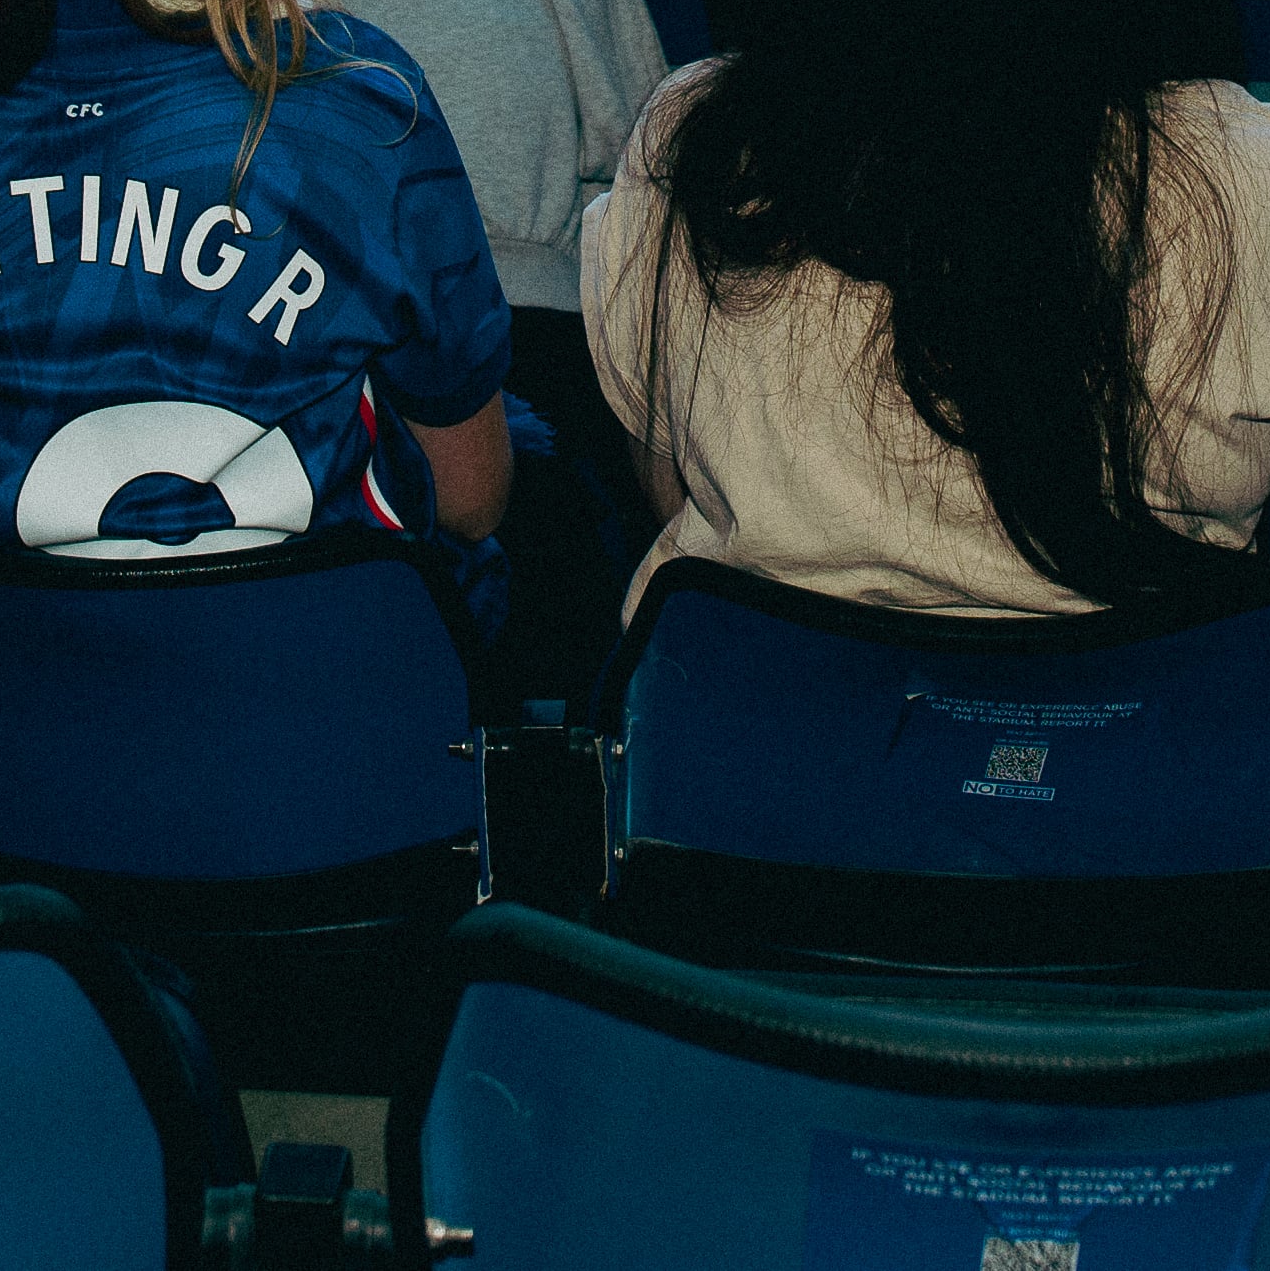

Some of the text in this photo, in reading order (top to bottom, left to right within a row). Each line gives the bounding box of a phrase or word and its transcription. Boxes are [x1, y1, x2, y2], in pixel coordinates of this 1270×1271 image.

[66, 102, 104, 118] CFC
[248, 248, 326, 346] R
[942, 696, 968, 706] YOU
[1103, 702, 1143, 711] ABUSE
[952, 712, 974, 721] THE
[1041, 720, 1089, 728] REPORT
[1041, 711, 1113, 719] BEHAVIOUR
[965, 781, 1050, 799] NO TO HATE
